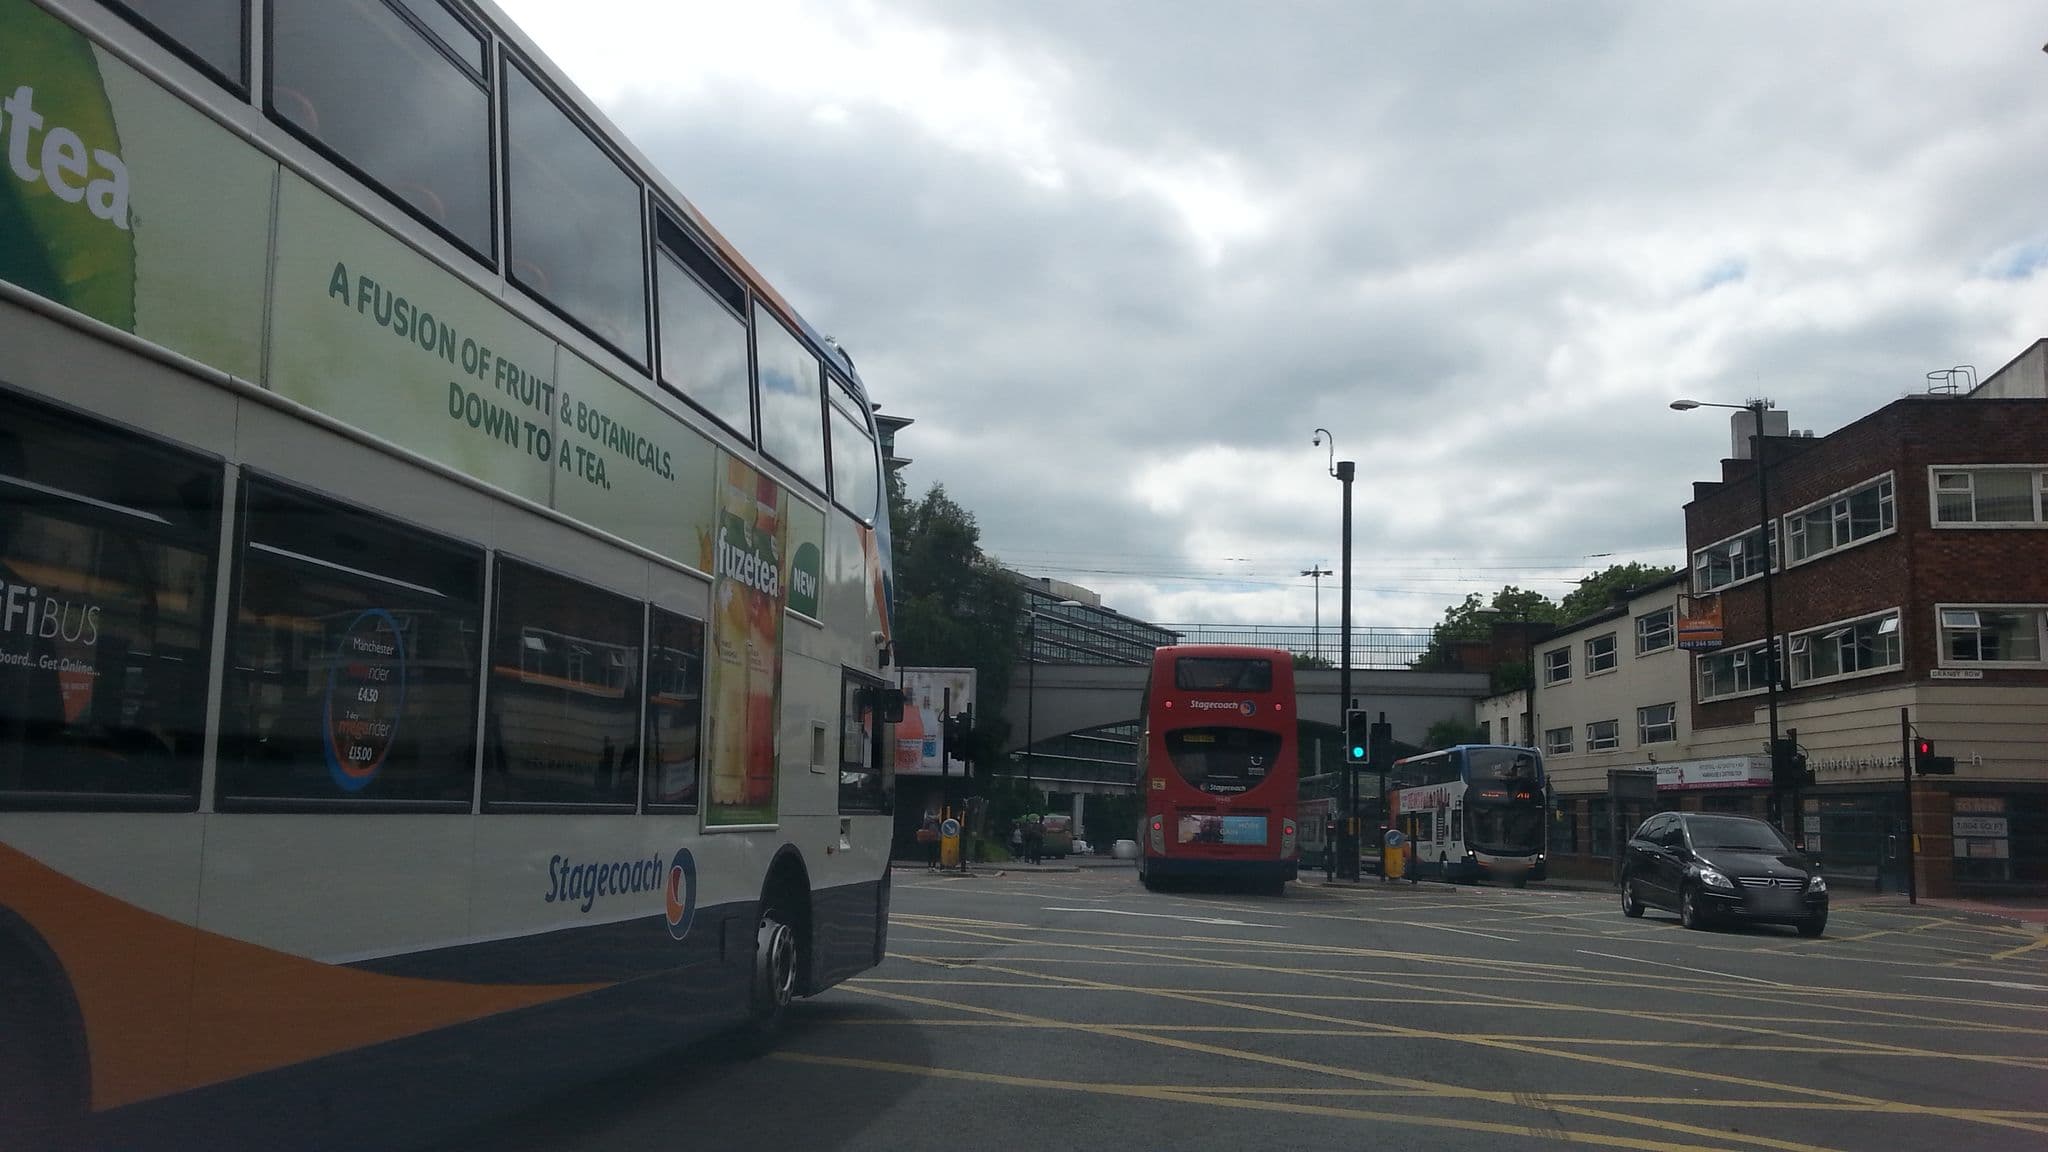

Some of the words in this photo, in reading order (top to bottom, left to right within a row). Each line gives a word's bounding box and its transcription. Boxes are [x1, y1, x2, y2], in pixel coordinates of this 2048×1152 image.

[0, 86, 130, 230] tea
[329, 261, 350, 307] A
[358, 275, 457, 365] FUSION
[461, 337, 493, 381] OF
[495, 356, 556, 417] FRUIT
[561, 392, 573, 427] &
[576, 401, 676, 483] BOTANICALS.
[448, 381, 520, 450] DOWN
[523, 421, 553, 463] TO
[559, 439, 572, 474] A
[576, 445, 611, 491] TEA.
[718, 526, 778, 598] fuzetea
[792, 567, 816, 600] NEW
[39, 654, 58, 671] Get
[353, 637, 395, 657] Manchester
[1188, 700, 1239, 711] Stagecoach
[349, 745, 373, 761] £15.00
[1209, 783, 1247, 793] Stagecoach
[544, 853, 663, 914] Stagecoach
